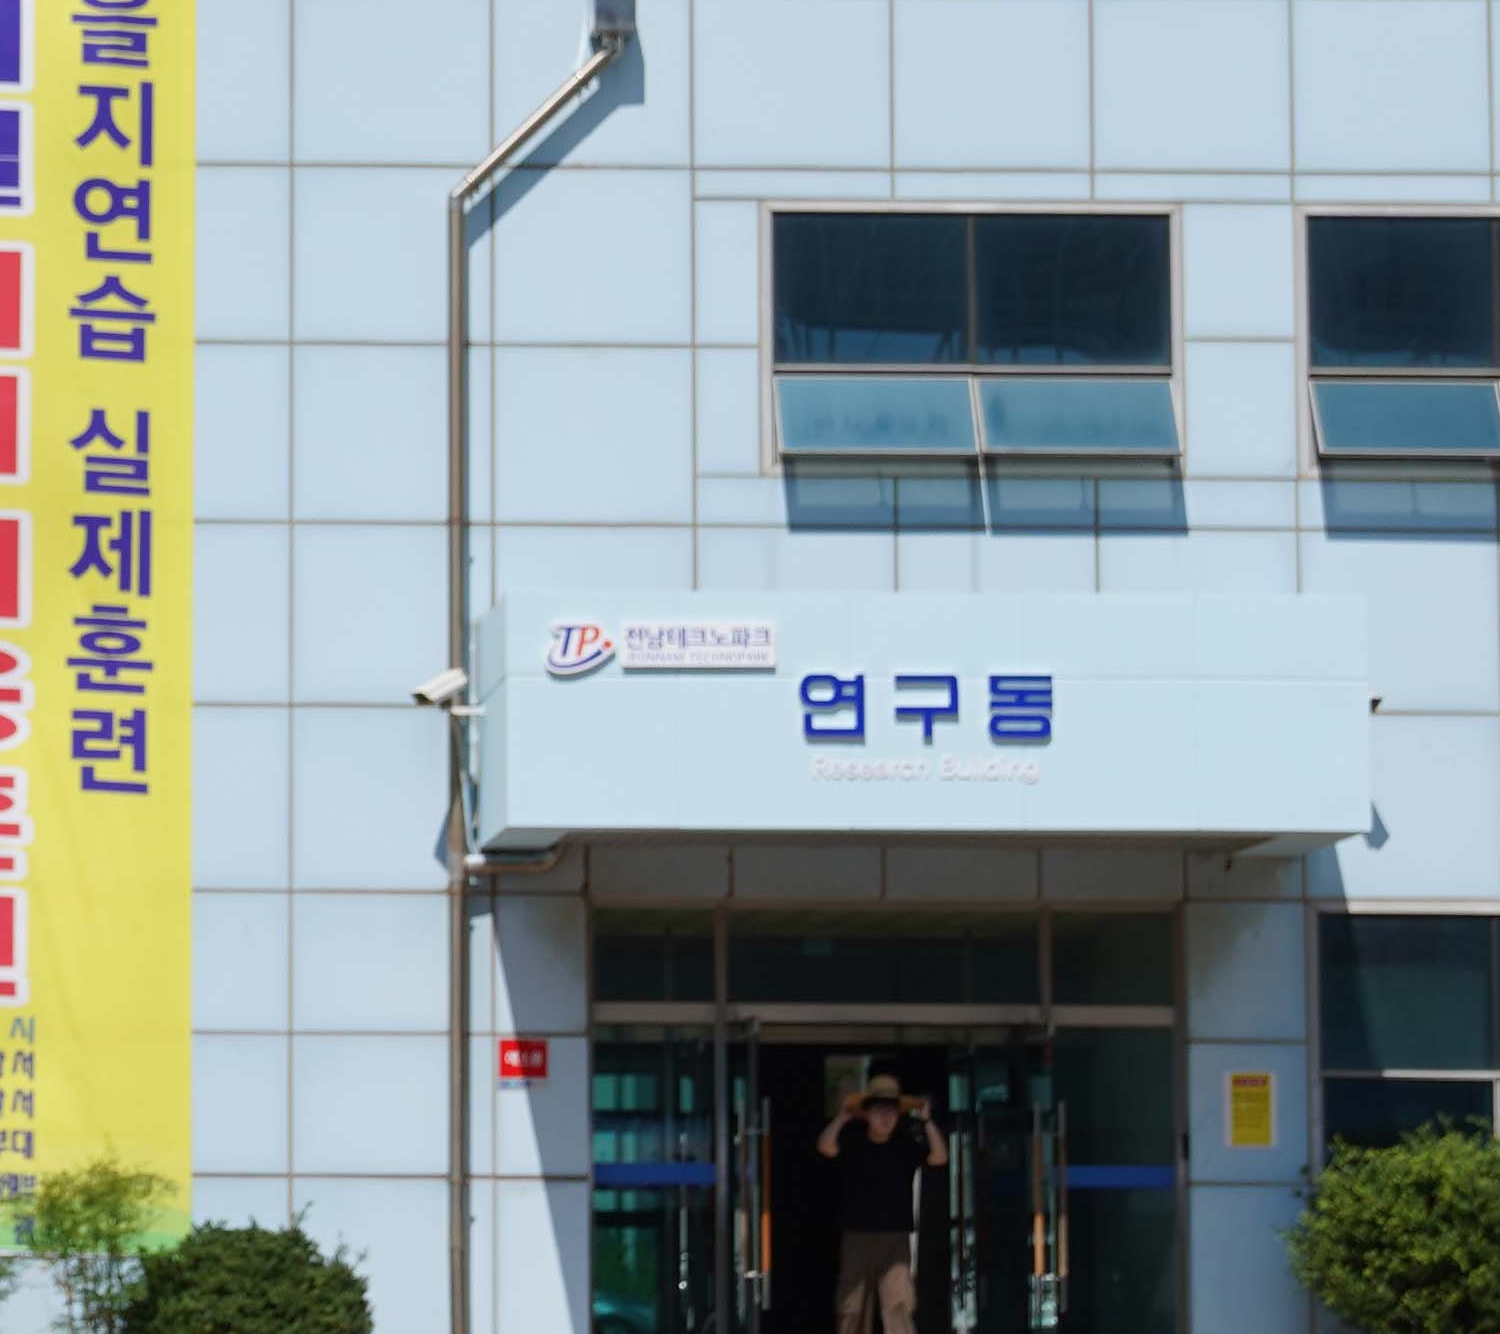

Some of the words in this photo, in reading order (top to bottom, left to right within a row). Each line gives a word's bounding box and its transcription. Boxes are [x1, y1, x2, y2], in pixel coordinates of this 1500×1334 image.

[68, 409, 153, 793] 실제훈련
[627, 625, 771, 651] 전남테크노파크
[798, 674, 1053, 744] 연구동
[813, 757, 930, 781] Research
[940, 756, 1040, 785] Building
